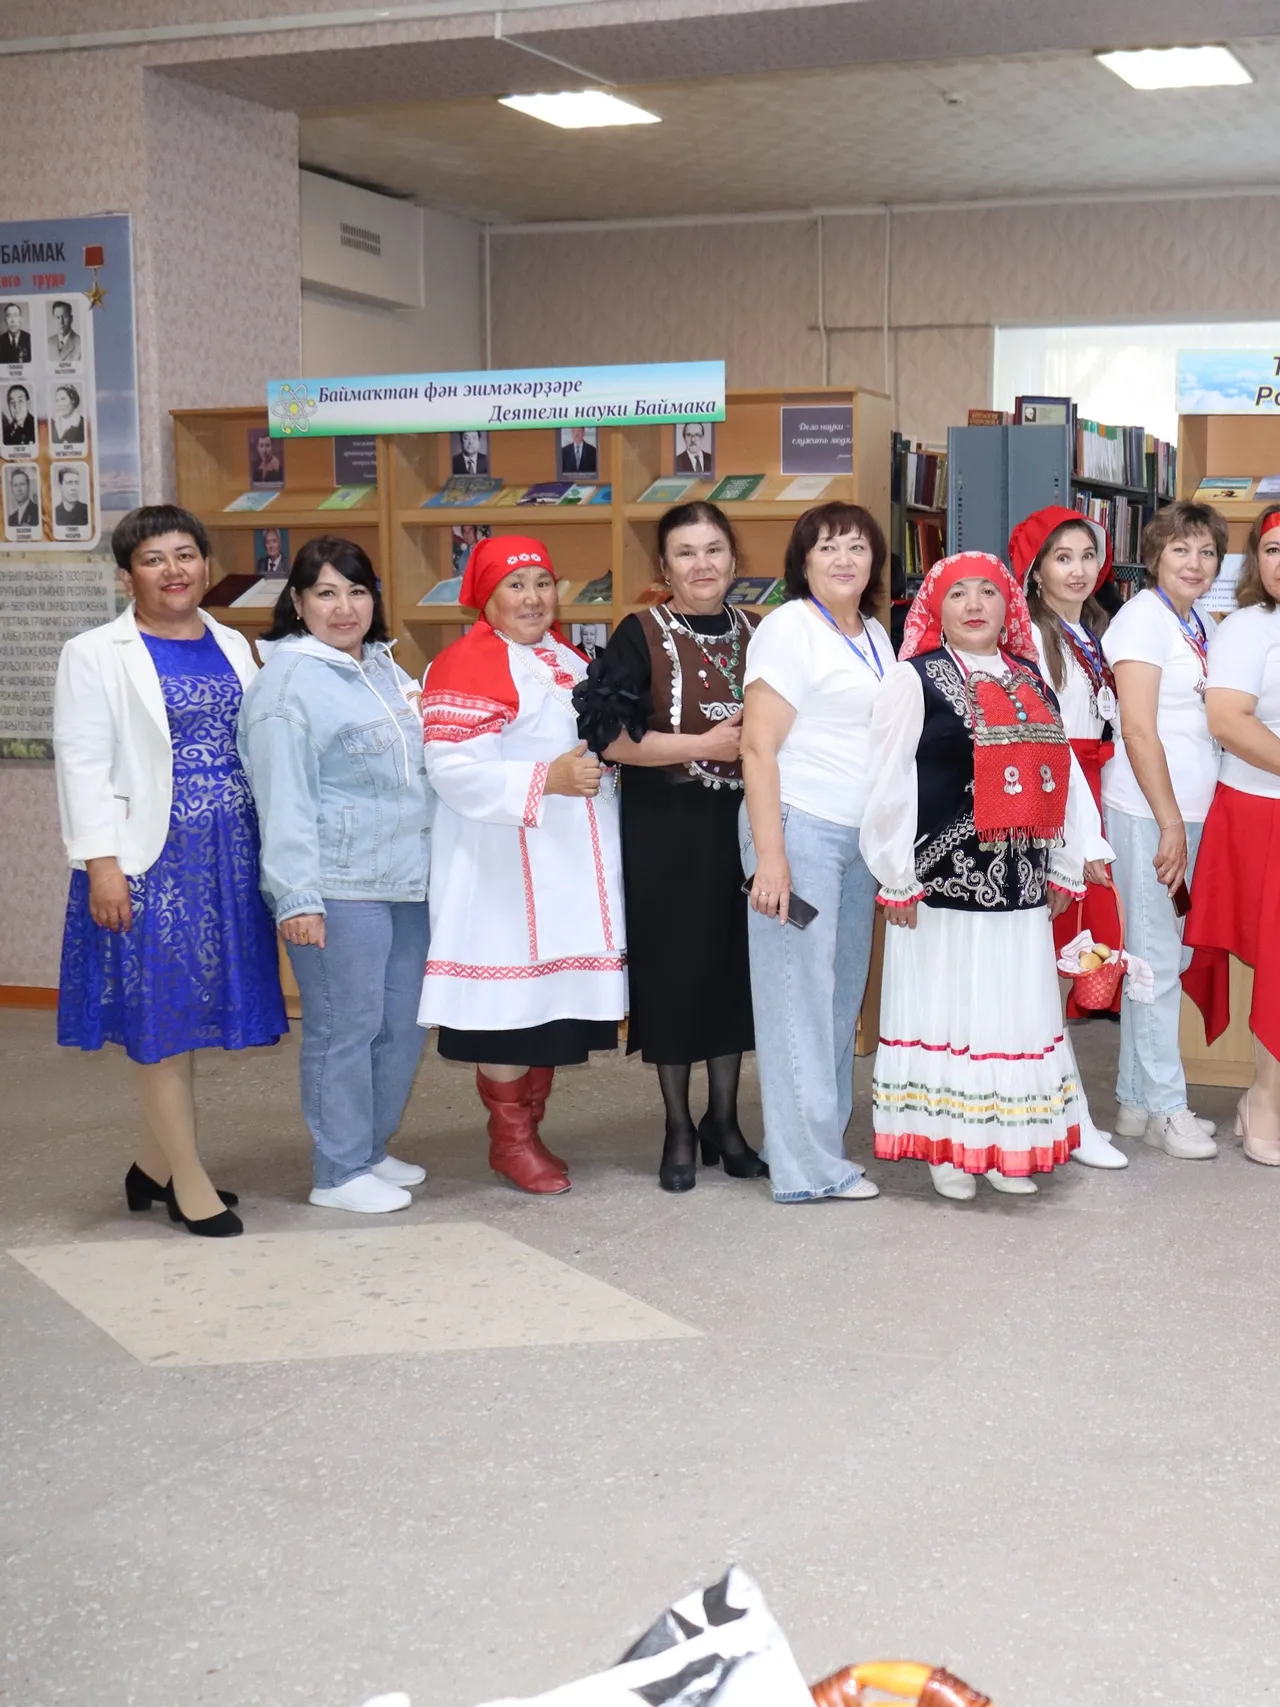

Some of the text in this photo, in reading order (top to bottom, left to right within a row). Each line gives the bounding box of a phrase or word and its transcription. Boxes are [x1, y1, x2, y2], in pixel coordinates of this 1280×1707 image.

[0, 238, 66, 264] БАЙМАК
[0, 274, 20, 288] ого
[424, 382, 457, 403] фән
[488, 398, 716, 423] Деятели науки Баймака
[799, 422, 819, 431] Дело
[820, 423, 844, 433] науки
[792, 436, 829, 447] служить
